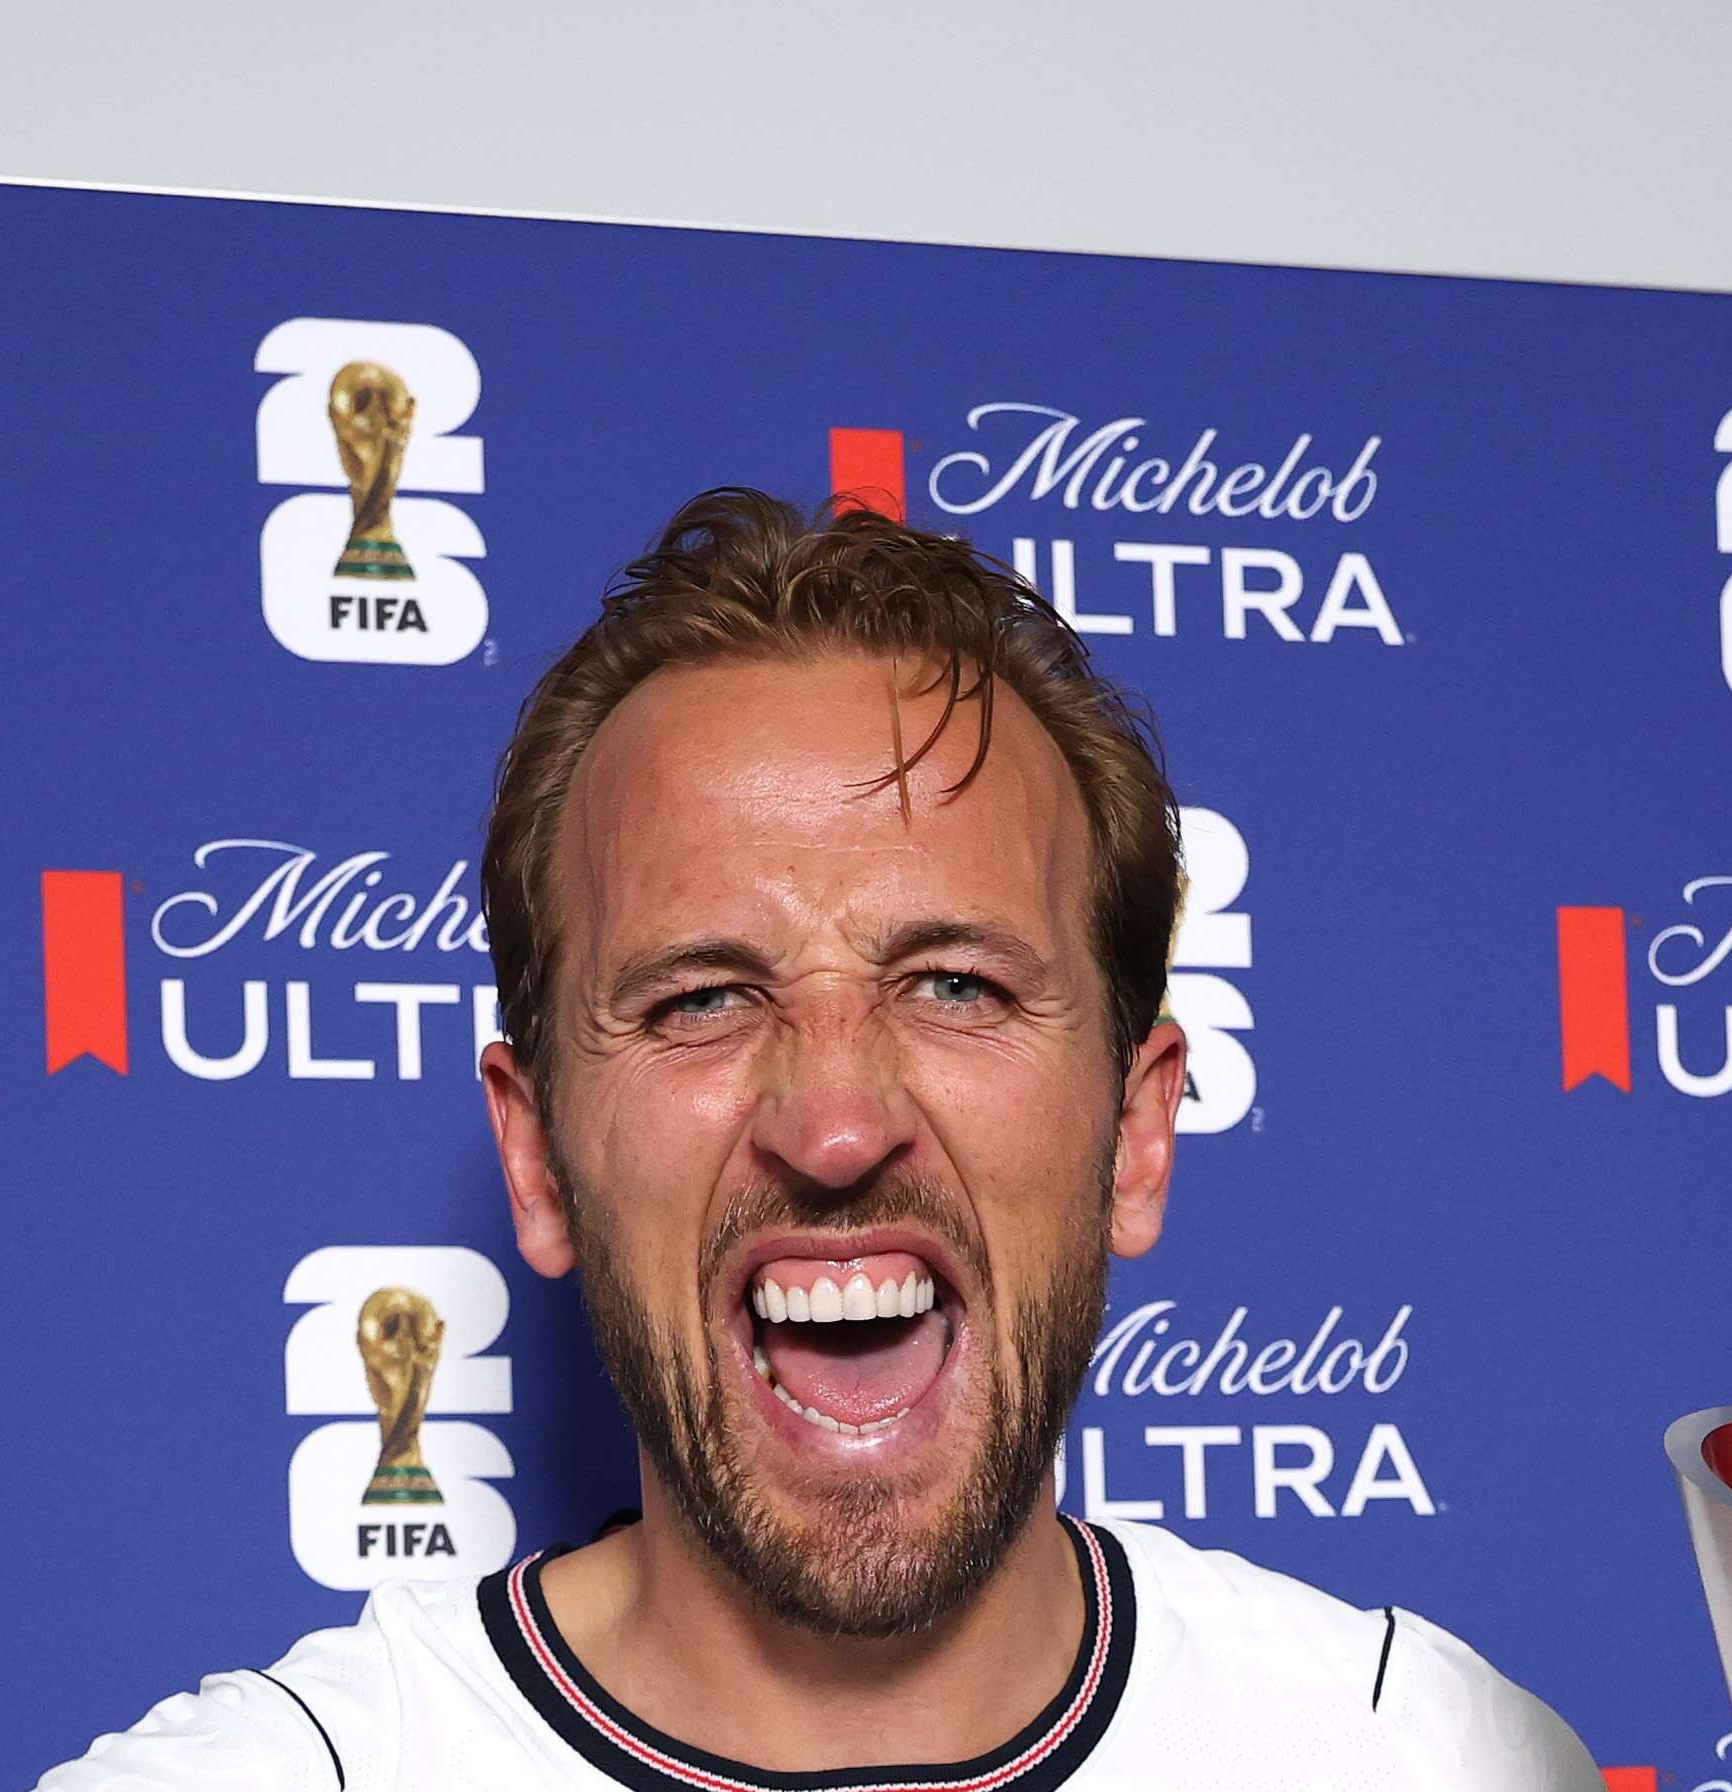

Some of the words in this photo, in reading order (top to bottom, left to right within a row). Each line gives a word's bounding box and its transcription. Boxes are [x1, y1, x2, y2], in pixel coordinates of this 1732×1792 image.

[929, 403, 1381, 521] Michelob
[331, 596, 427, 632] FIFA
[152, 840, 490, 957] Mich
[160, 978, 507, 1082] ULT
[1055, 1423, 1436, 1520] LTRA
[359, 1524, 456, 1556] FIFA
